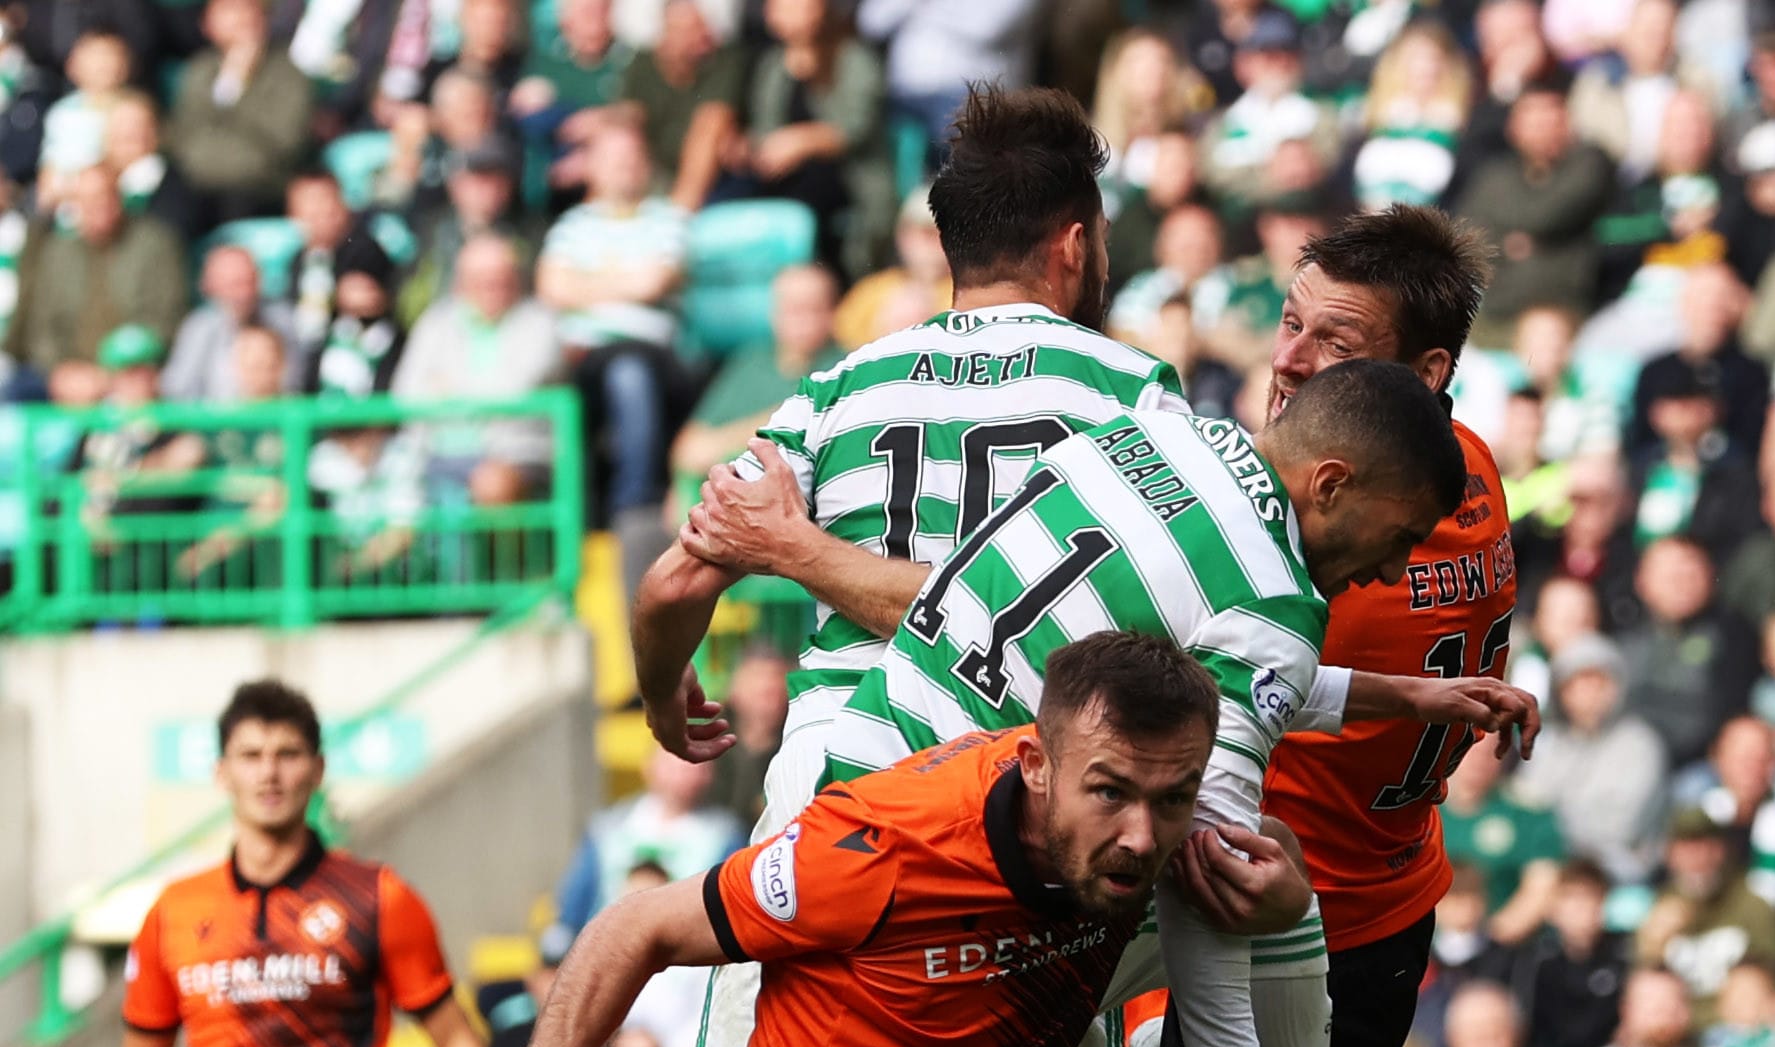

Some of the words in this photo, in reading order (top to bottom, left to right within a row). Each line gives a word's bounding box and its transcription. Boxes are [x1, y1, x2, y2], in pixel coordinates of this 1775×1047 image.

[909, 344, 1038, 387] AJETI
[1094, 425, 1200, 522] ABADA
[1193, 418, 1285, 522] GNERS
[903, 462, 1120, 709] 11
[769, 846, 789, 908] cinch
